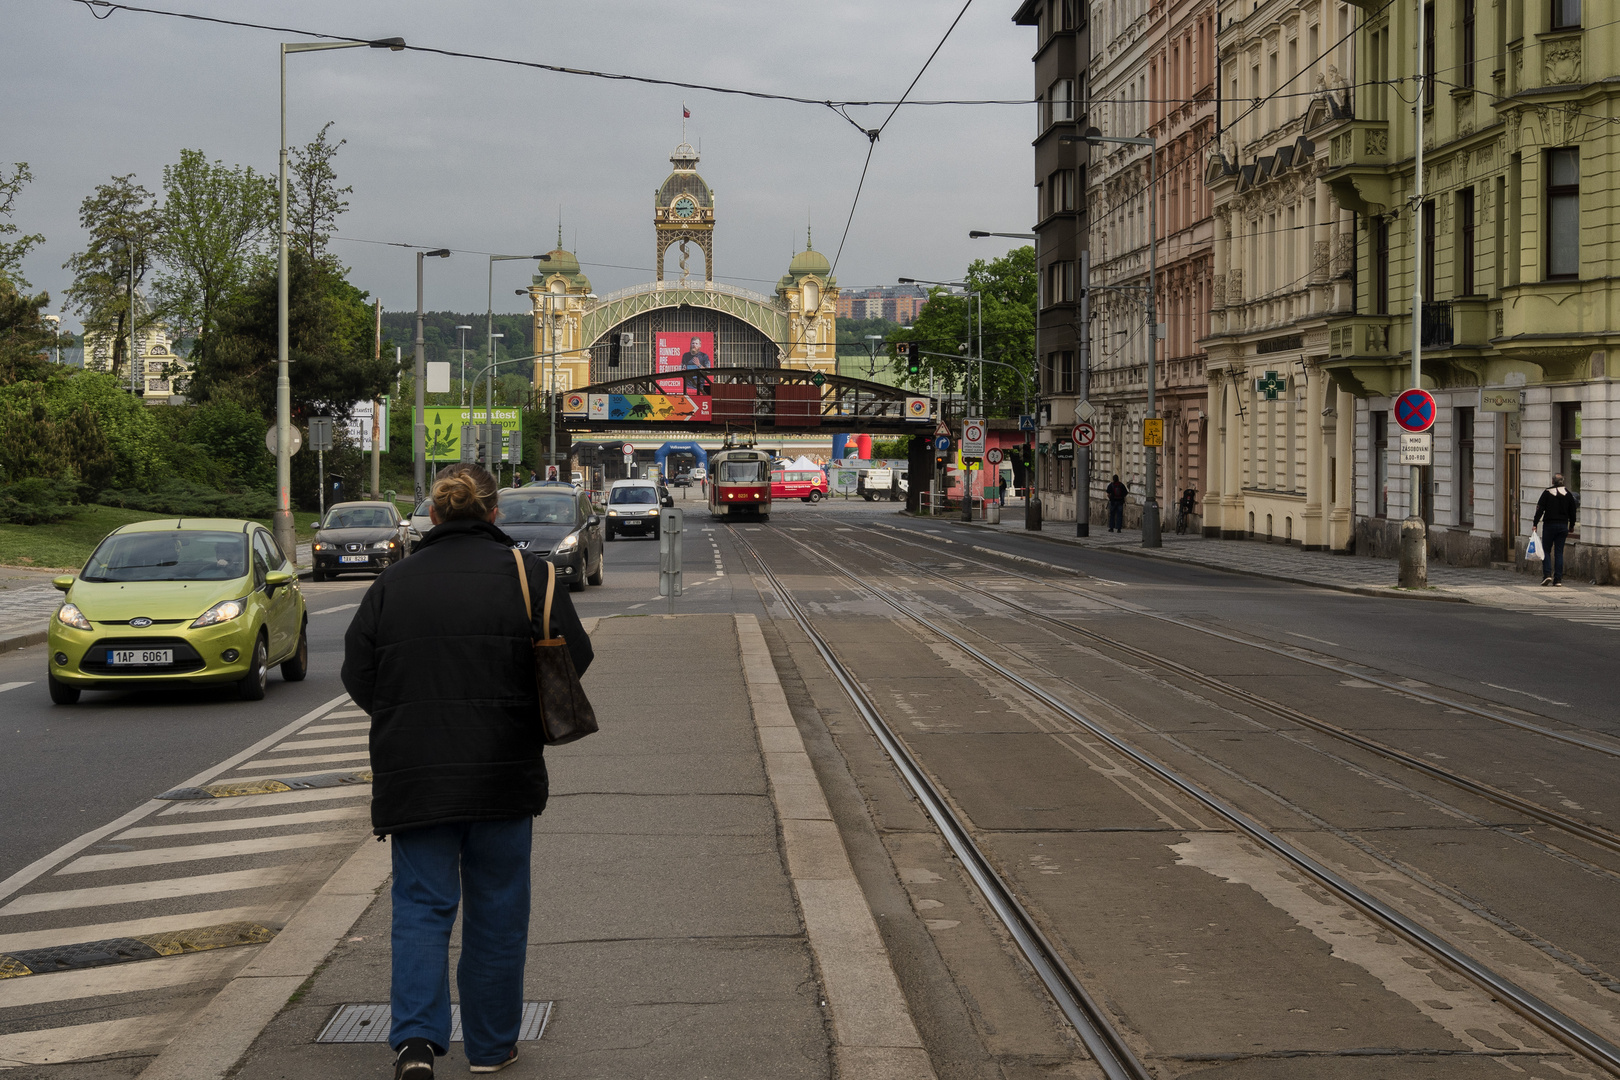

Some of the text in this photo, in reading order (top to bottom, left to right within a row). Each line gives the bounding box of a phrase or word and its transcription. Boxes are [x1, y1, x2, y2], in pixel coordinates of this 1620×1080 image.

[659, 339, 667, 347] ALL
[659, 347, 680, 356] RUNNERS
[659, 356, 669, 364] ARE
[1483, 396, 1517, 405] STROMKA
[702, 401, 709, 410] 5
[116, 651, 135, 663] 1AP
[142, 651, 168, 662] 6061
